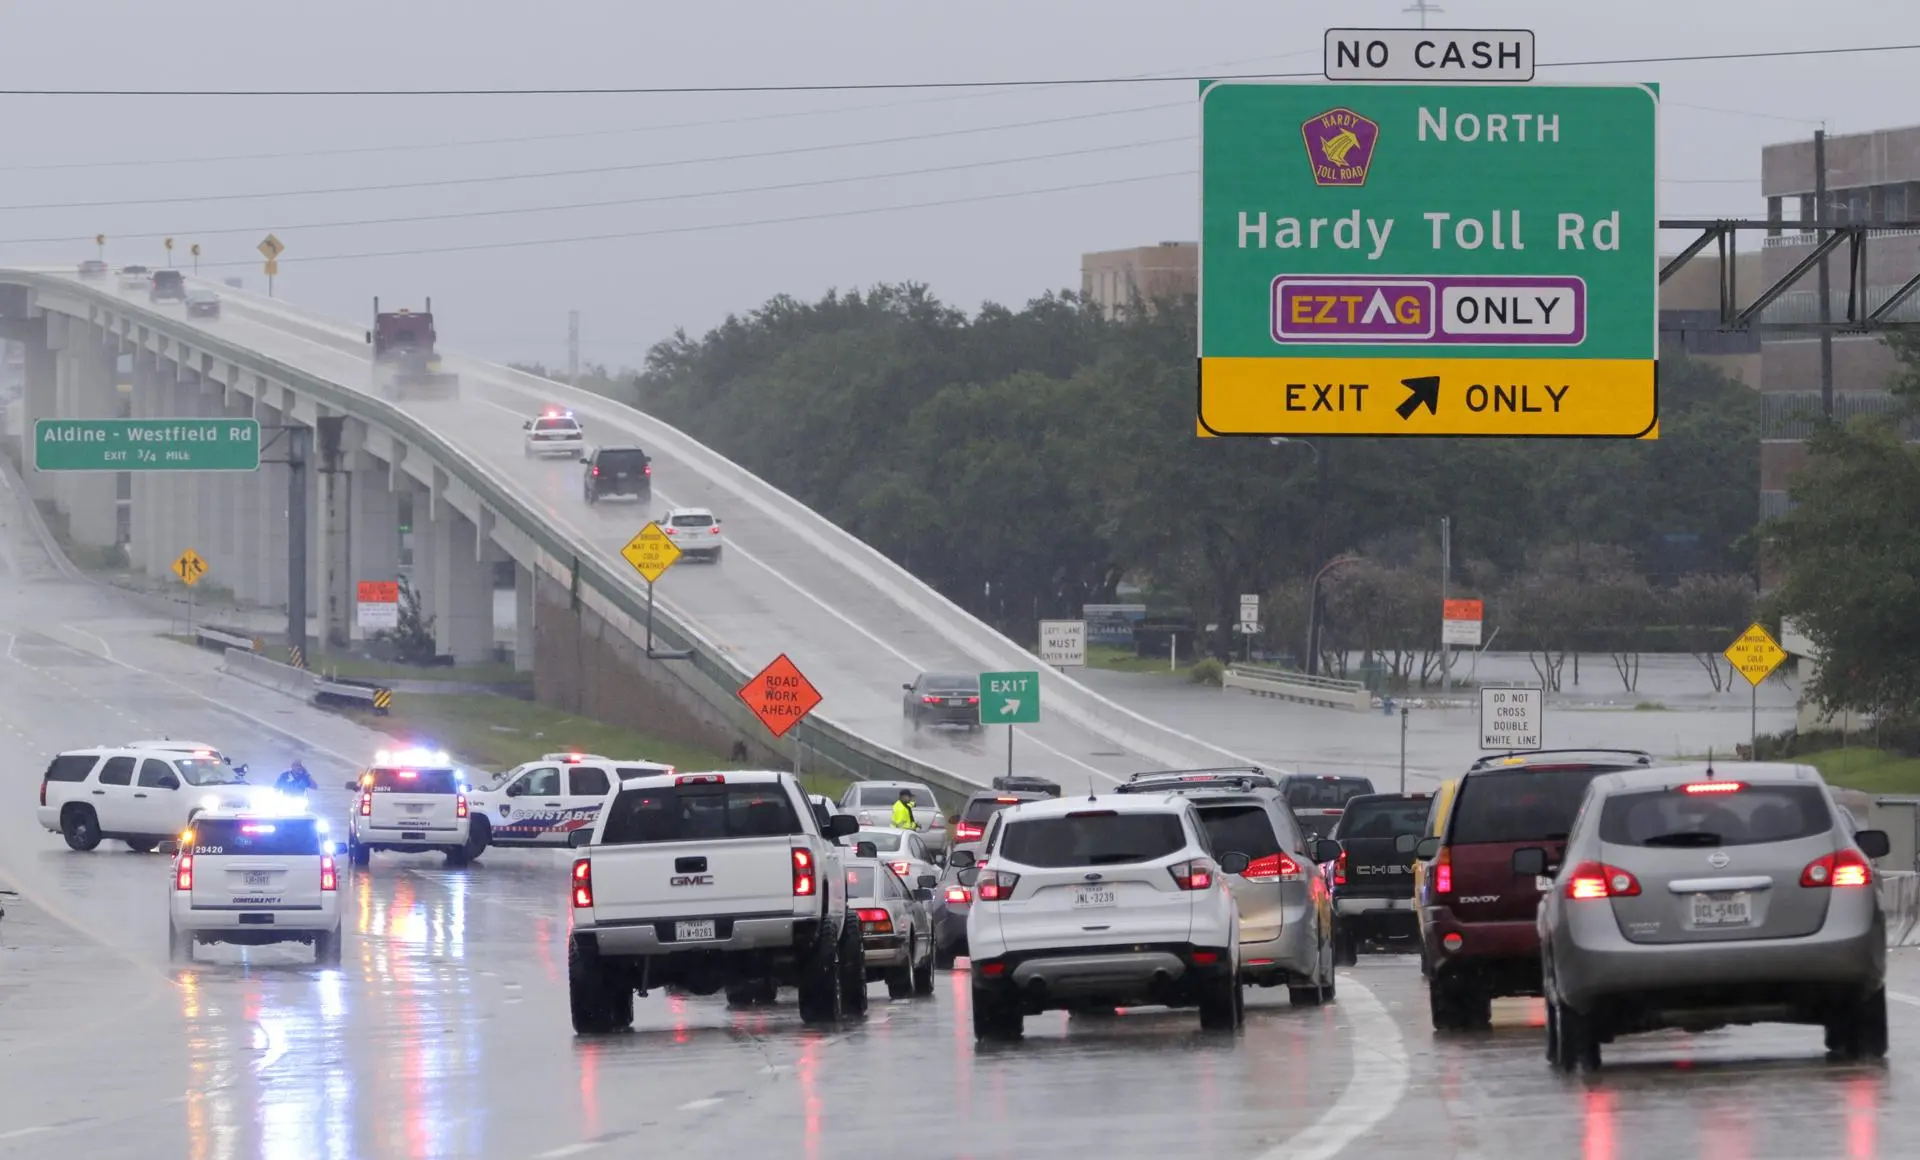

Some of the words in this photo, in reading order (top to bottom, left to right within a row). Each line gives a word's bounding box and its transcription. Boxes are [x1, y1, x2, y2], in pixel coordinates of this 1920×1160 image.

[1336, 39, 1389, 69] NO
[1413, 40, 1522, 70] CASH
[1320, 114, 1360, 129] HARDY
[1417, 106, 1561, 143] NORTH
[1316, 164, 1337, 180] TOLL
[1340, 165, 1364, 180] ROAD
[1237, 209, 1395, 260] Hardy
[1423, 210, 1525, 251] Toll
[1557, 210, 1622, 251] Rd
[1455, 296, 1561, 326] ONLY
[1286, 383, 1370, 412] EXIT
[1465, 384, 1571, 413] ONLY
[44, 427, 106, 442] Aldine
[127, 427, 217, 442] Westfield
[229, 427, 252, 441] Rd
[104, 451, 127, 461] EXIT
[166, 451, 191, 461] MILE
[1044, 626, 1060, 635] LEFT
[1064, 626, 1081, 635] LANE
[1048, 639, 1077, 649] MUST
[1741, 664, 1769, 673] WEATHER
[766, 675, 799, 687] ROAD
[990, 679, 1028, 692] EXIT
[765, 690, 798, 701] WORK
[1493, 693, 1506, 703] DO
[1511, 693, 1529, 703] NOT
[761, 705, 802, 716] AHEAD
[1496, 707, 1526, 717] CROSS
[1493, 721, 1529, 731] DOUBLE
[1485, 735, 1511, 745] WHITE
[1517, 735, 1537, 745] LINE
[511, 809, 601, 821] CONSTABLE
[195, 846, 223, 854] 29420
[670, 875, 714, 887] GMC
[1459, 894, 1501, 904] ENVOY
